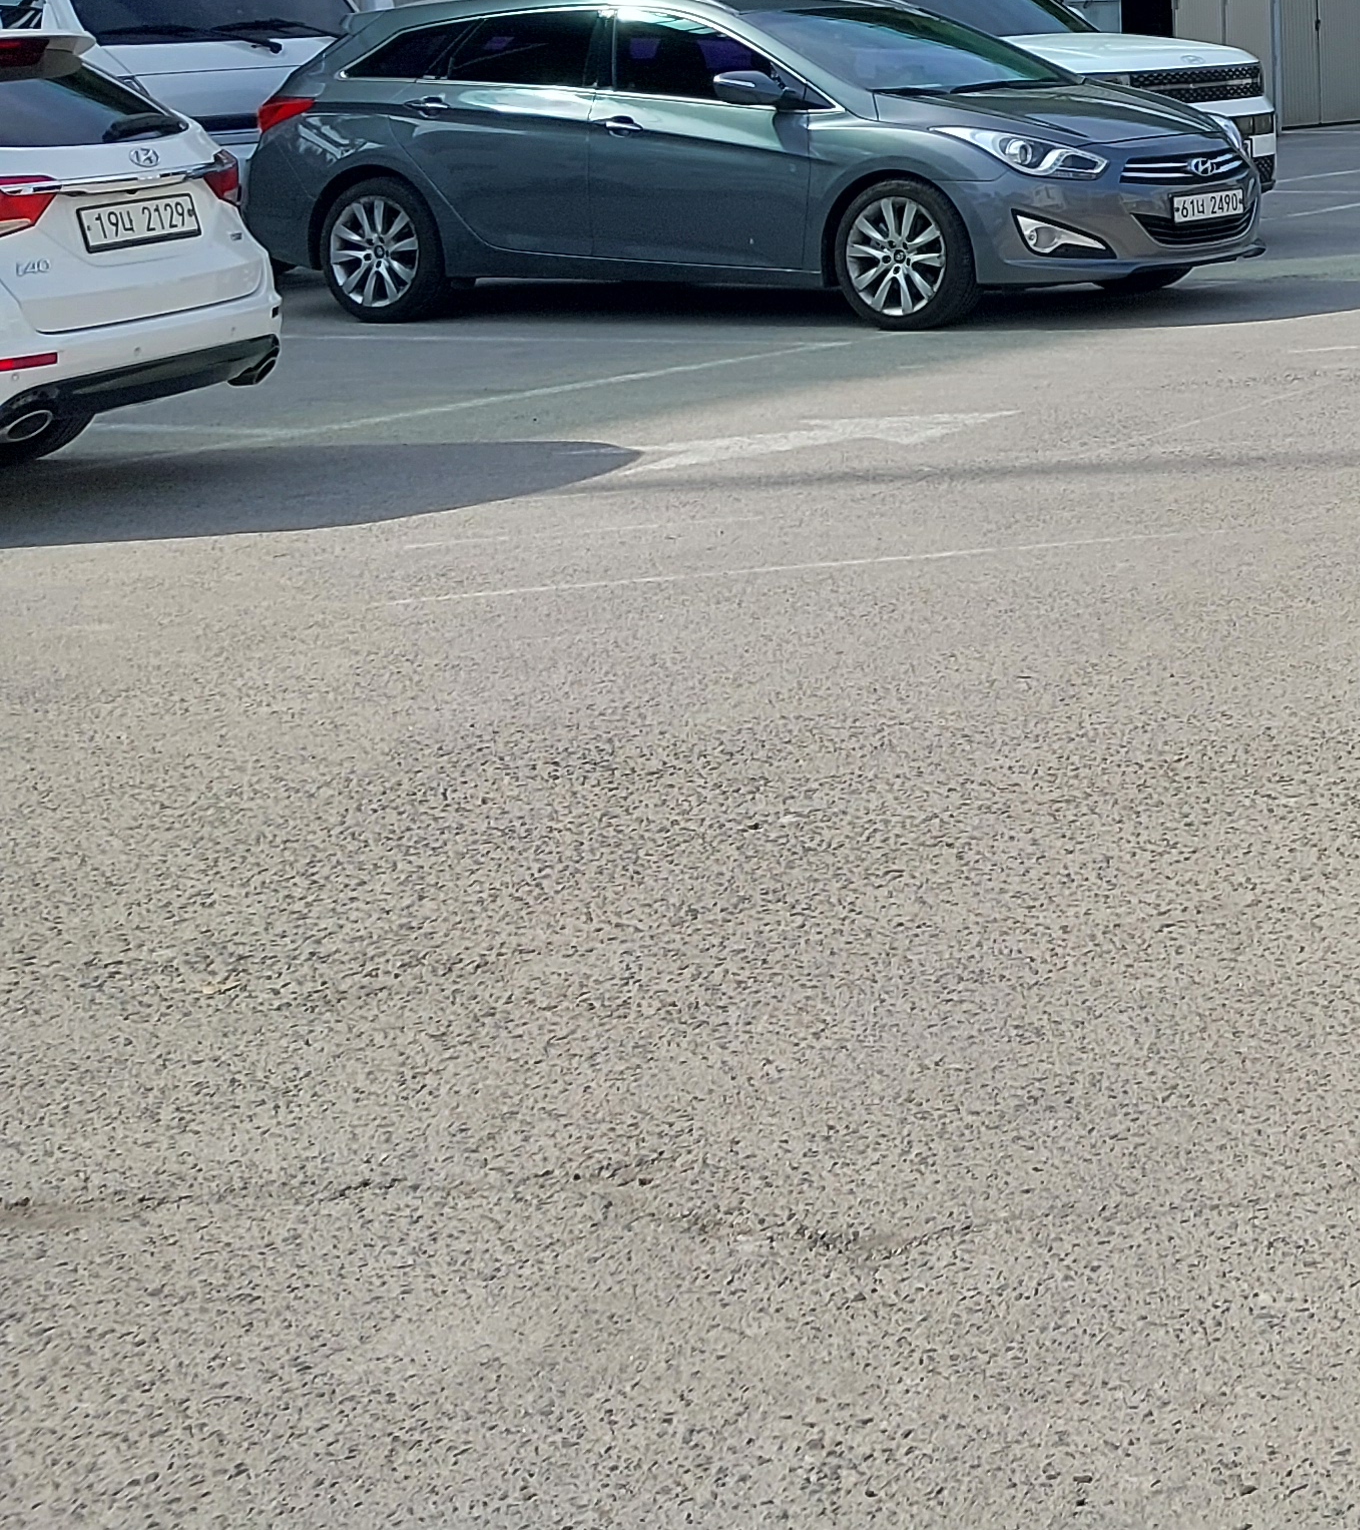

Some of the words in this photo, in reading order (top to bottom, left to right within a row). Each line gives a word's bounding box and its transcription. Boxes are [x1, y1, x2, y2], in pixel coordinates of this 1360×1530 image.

[94, 211, 136, 239] 19나
[141, 201, 186, 233] 2129
[1181, 198, 1205, 218] 61너
[1210, 193, 1238, 215] 2490
